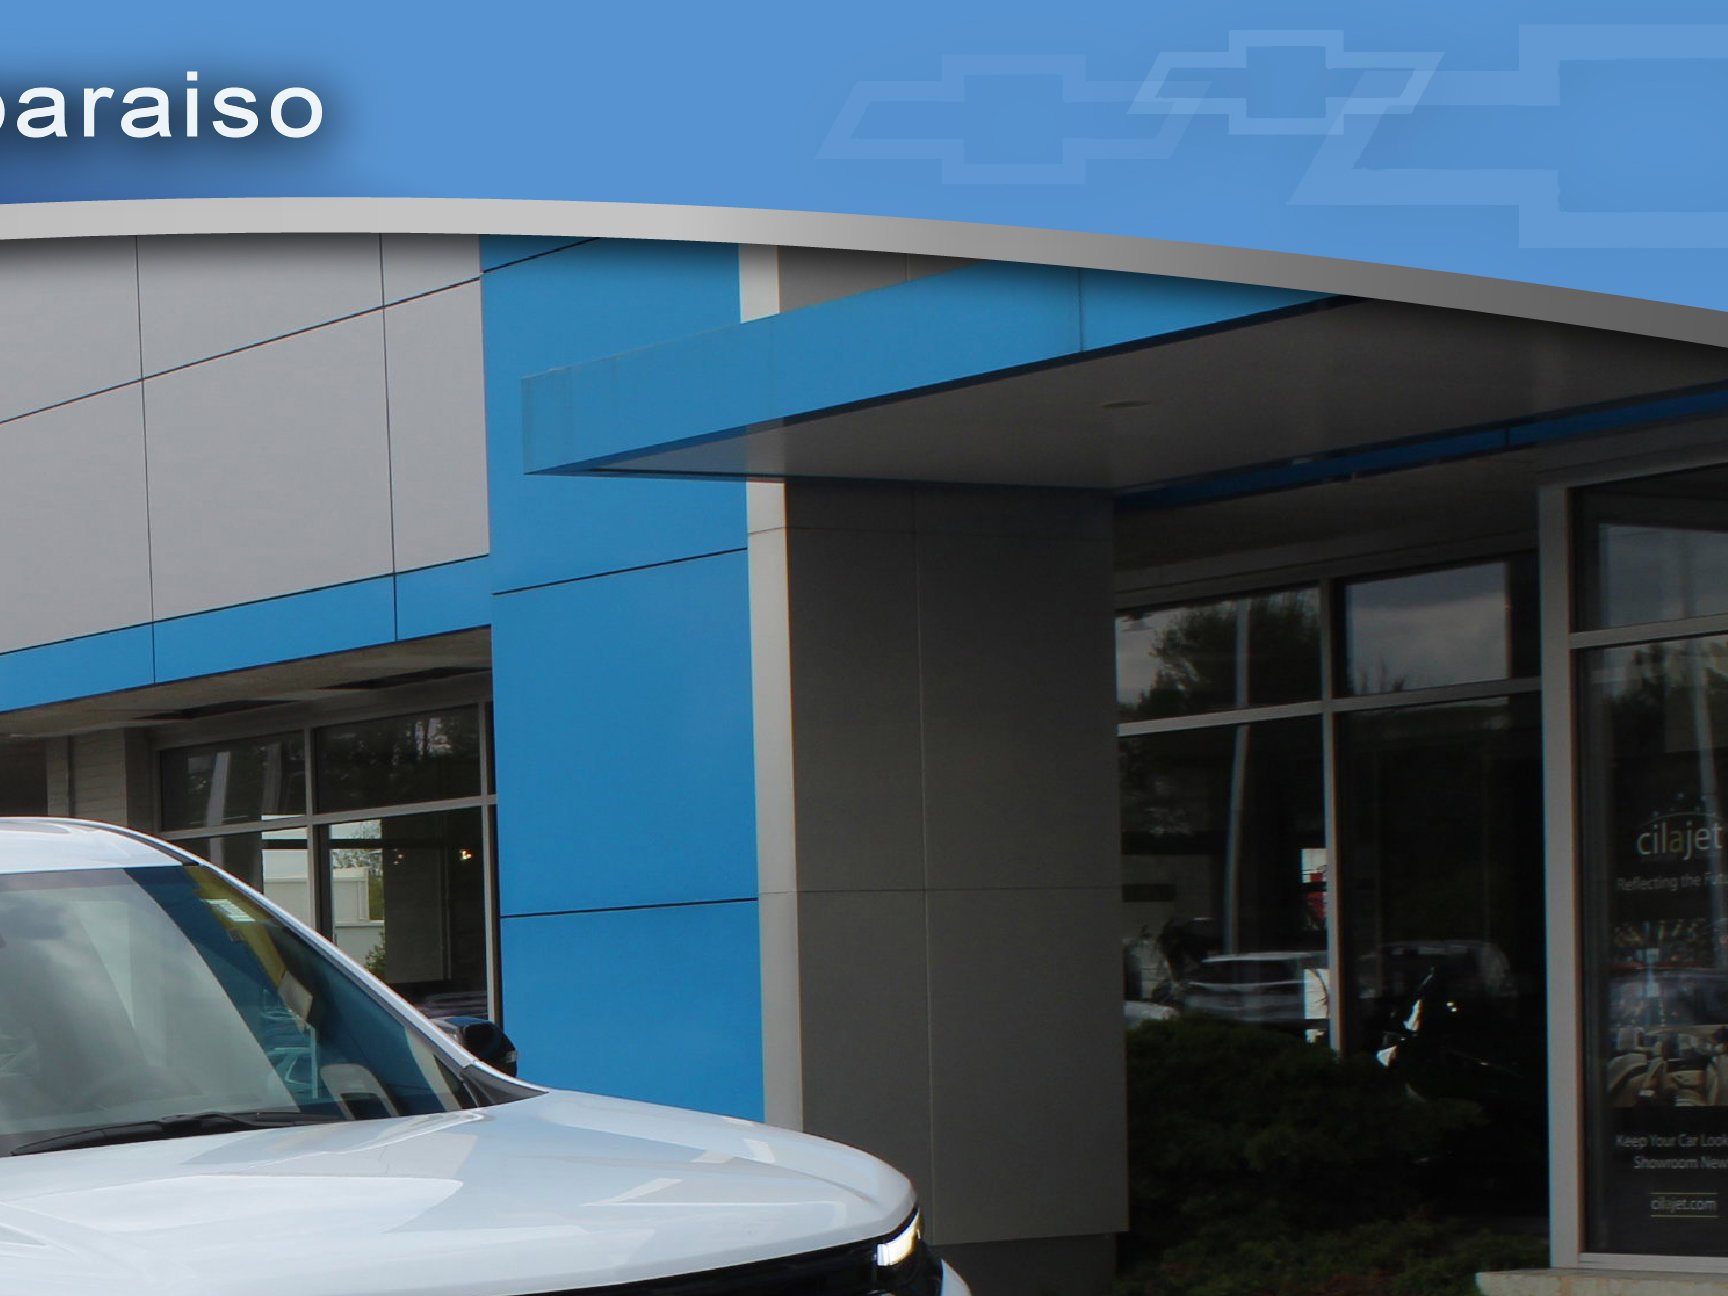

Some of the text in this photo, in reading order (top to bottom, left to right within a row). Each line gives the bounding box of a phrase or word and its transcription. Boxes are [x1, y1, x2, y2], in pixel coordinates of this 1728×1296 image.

[1635, 820, 1724, 861] cilajet
[1615, 874, 1679, 891] Reflecting
[1615, 1134, 1648, 1150] Keep
[1648, 1134, 1677, 1148] Your
[1678, 1133, 1699, 1147] Car
[1633, 1155, 1698, 1169] Showroom
